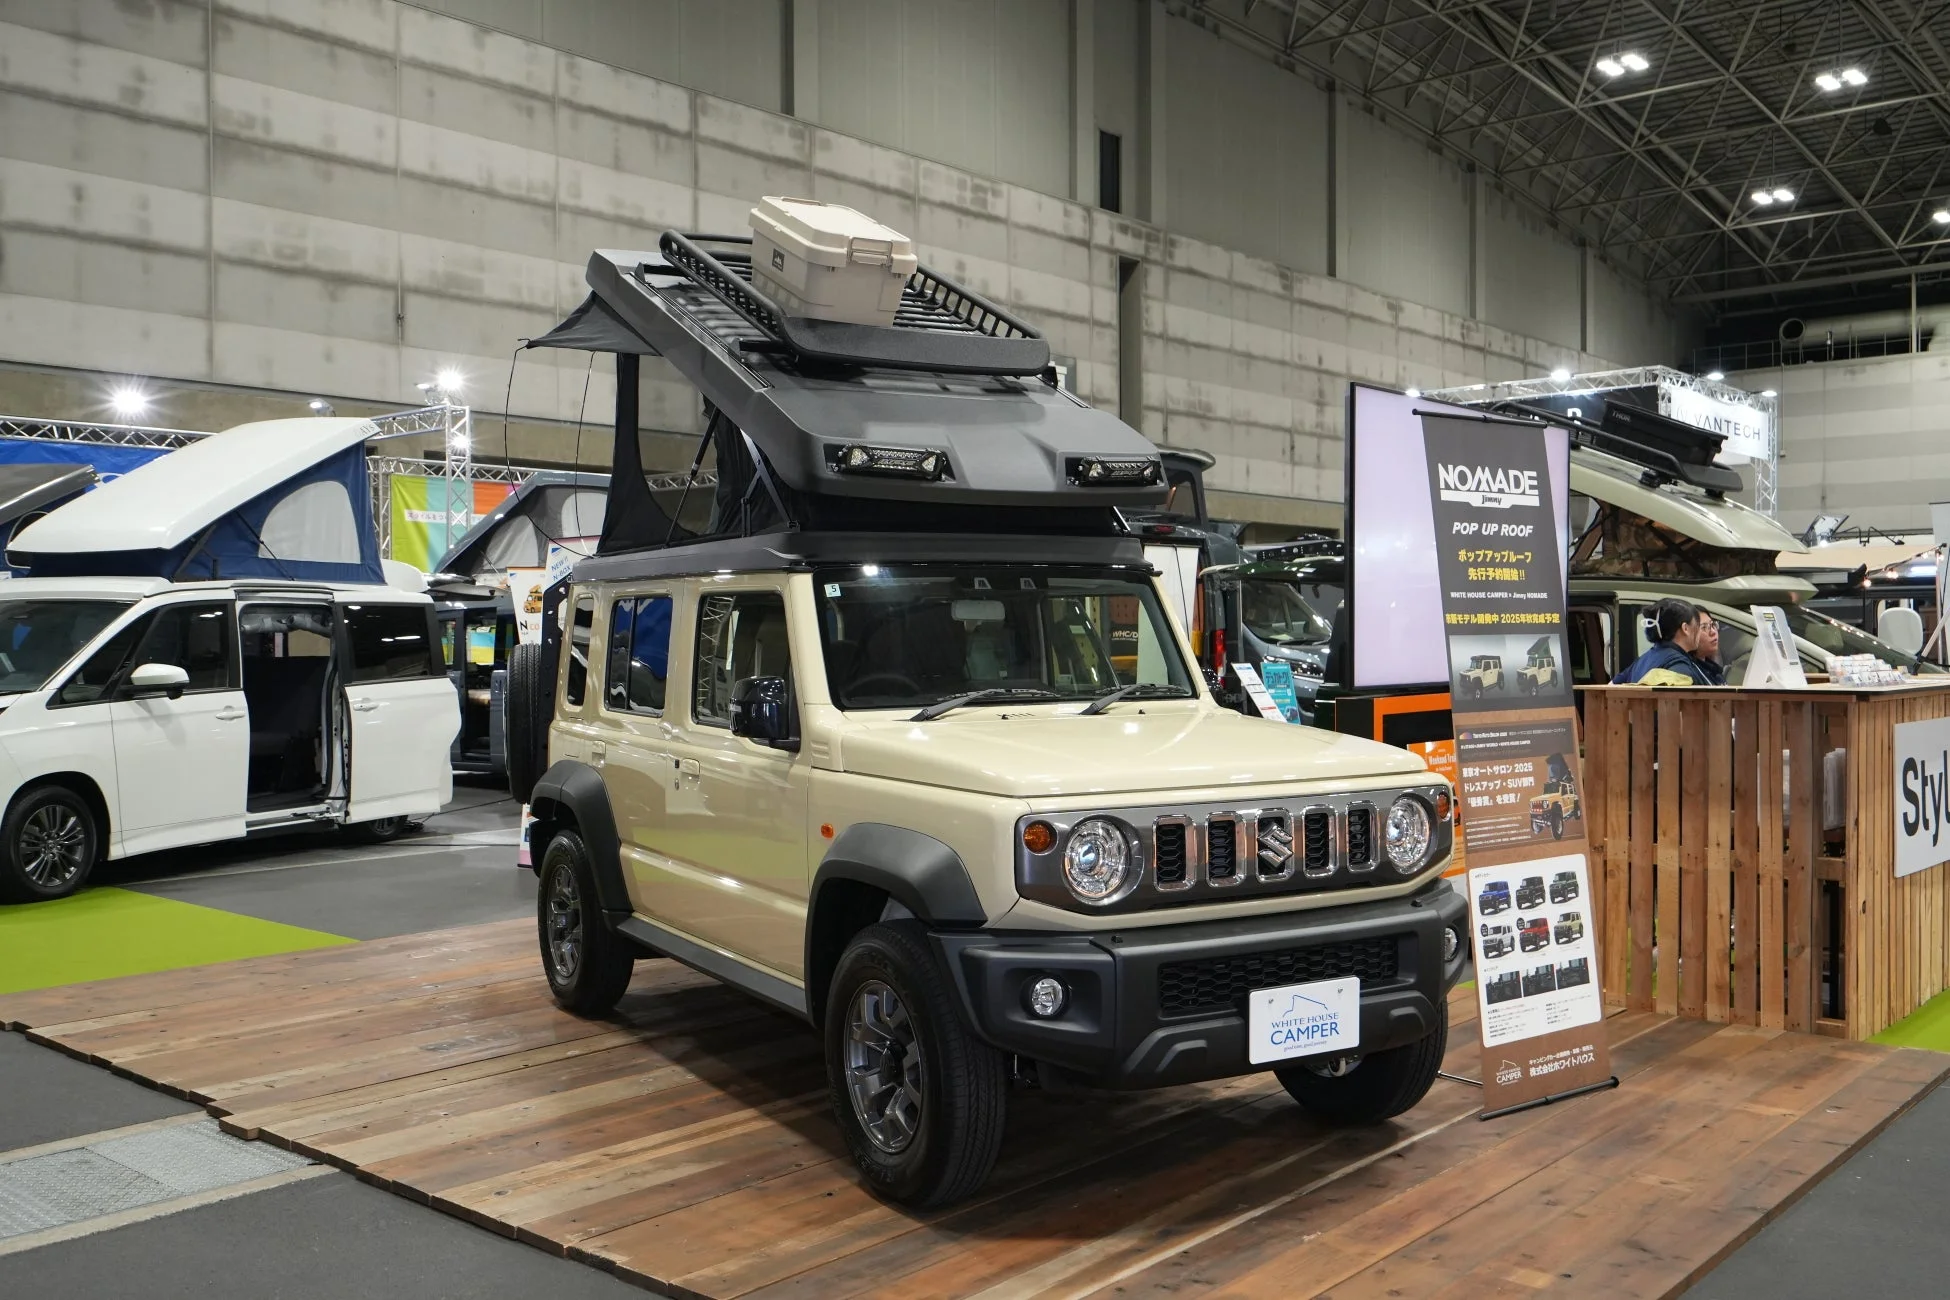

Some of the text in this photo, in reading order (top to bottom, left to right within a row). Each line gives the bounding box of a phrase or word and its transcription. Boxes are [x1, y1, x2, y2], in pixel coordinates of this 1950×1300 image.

[1694, 413, 1761, 441] VANTECH
[1438, 463, 1539, 495] NOMADE
[1481, 494, 1502, 506] Jimny
[1452, 522, 1534, 538] POP UP ROOF
[831, 584, 837, 593] 5
[519, 619, 528, 631] N
[1514, 762, 1533, 773] 2025
[1271, 1012, 1339, 1029] WHITE HOUSE
[1270, 1021, 1340, 1045] CAMPER
[1529, 1052, 1595, 1077] 株式会社ホワイトハウス
[1496, 1071, 1522, 1084] CAMPER
